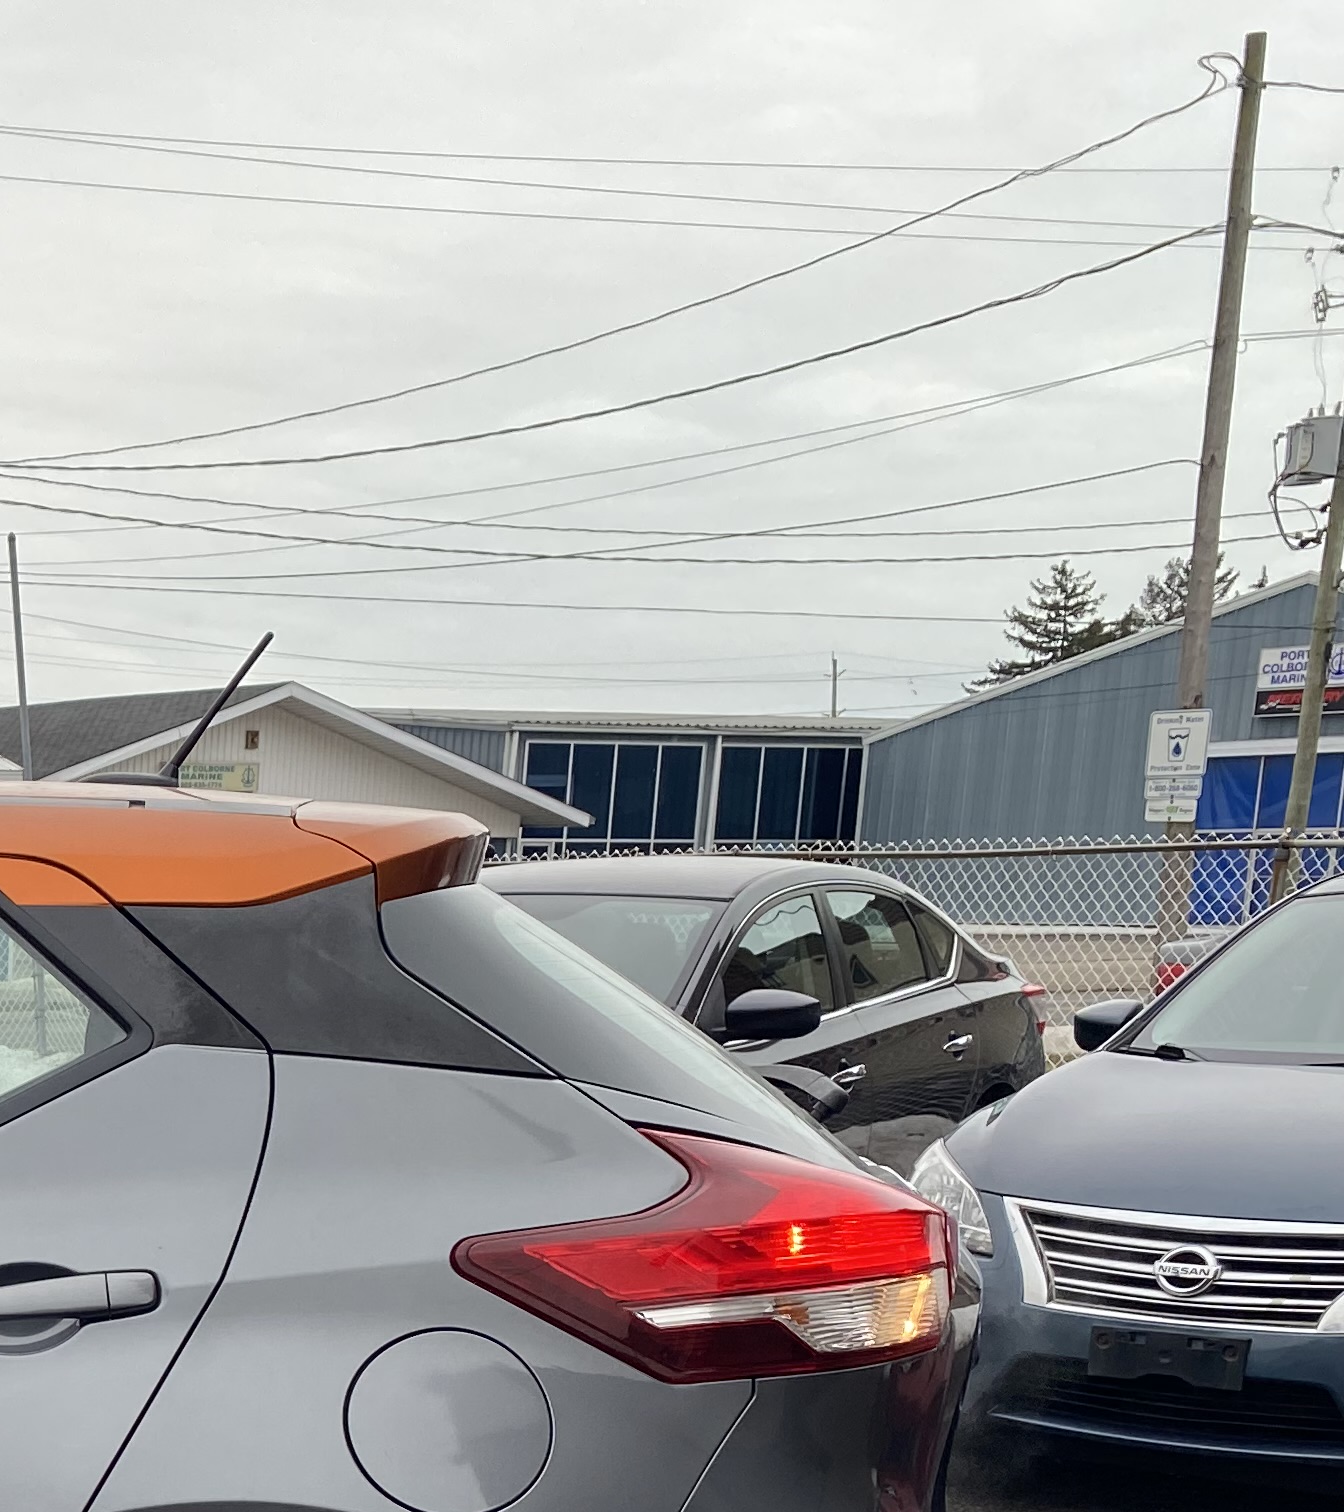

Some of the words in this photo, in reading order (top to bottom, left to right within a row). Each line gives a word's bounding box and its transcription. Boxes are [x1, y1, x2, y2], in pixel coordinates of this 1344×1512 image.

[1262, 661, 1308, 674] COLBO
[1271, 673, 1307, 685] MARIN
[180, 773, 223, 781] MARINE
[1158, 1265, 1210, 1276] NISSAN
